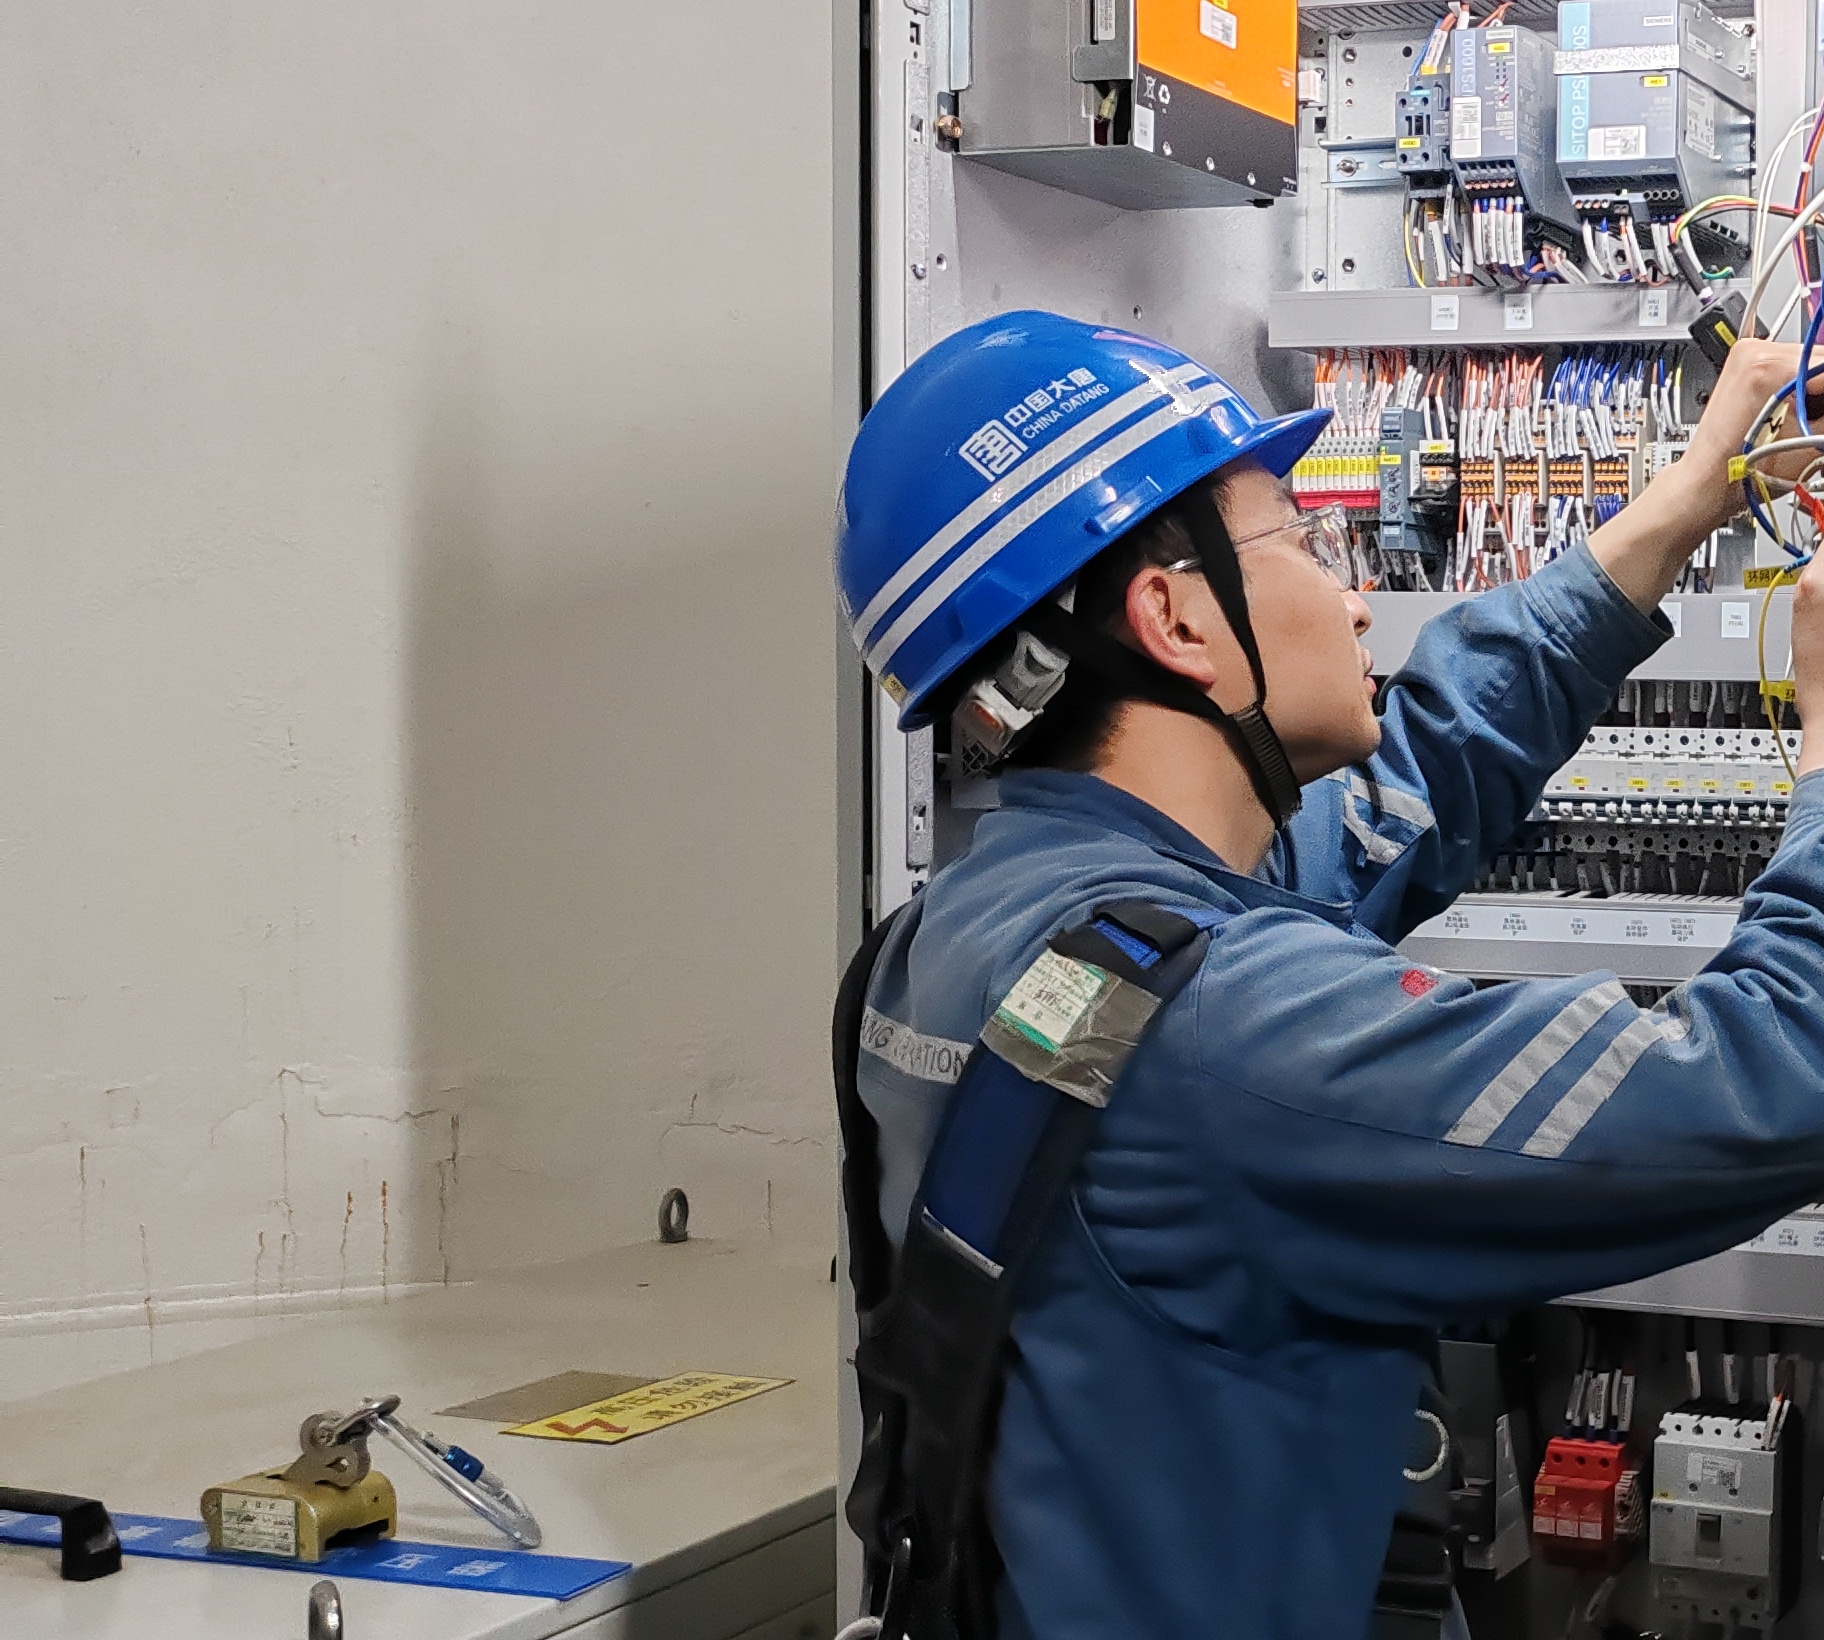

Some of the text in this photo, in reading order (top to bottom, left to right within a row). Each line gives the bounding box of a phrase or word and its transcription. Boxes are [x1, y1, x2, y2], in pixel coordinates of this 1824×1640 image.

[1571, 105, 1586, 155] SITOP
[1003, 367, 1098, 428] 中国大唐
[1022, 383, 1110, 439] CHINA DATANG
